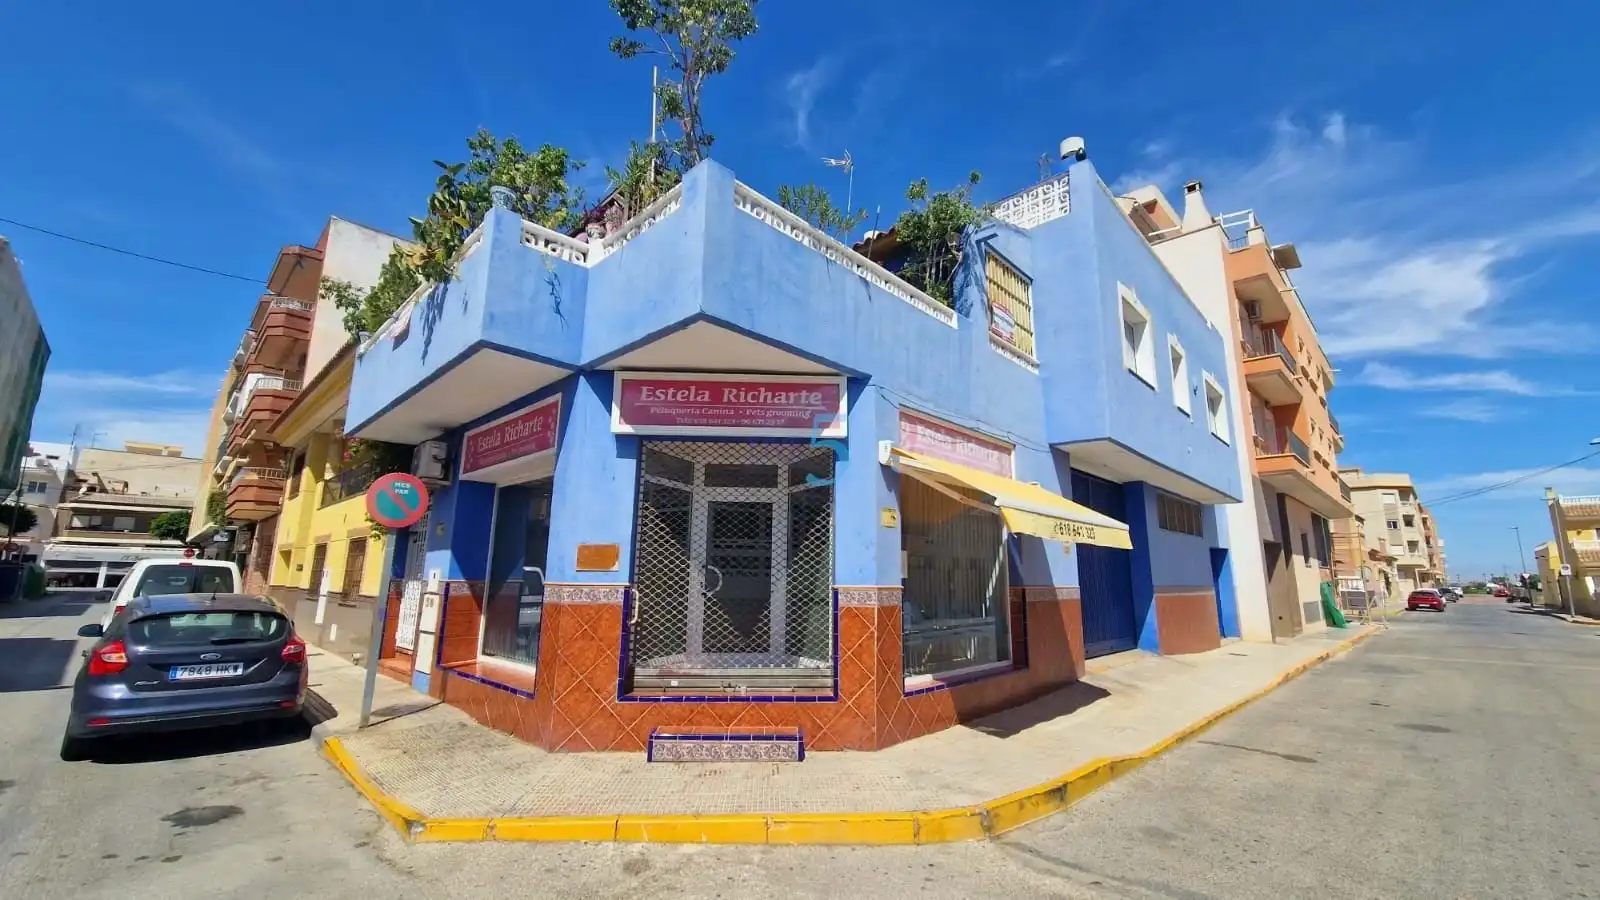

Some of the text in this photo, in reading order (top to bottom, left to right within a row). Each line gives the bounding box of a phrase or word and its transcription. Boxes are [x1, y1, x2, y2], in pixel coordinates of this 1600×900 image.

[640, 386, 823, 406] Estela Richarte
[504, 416, 544, 443] Richarte
